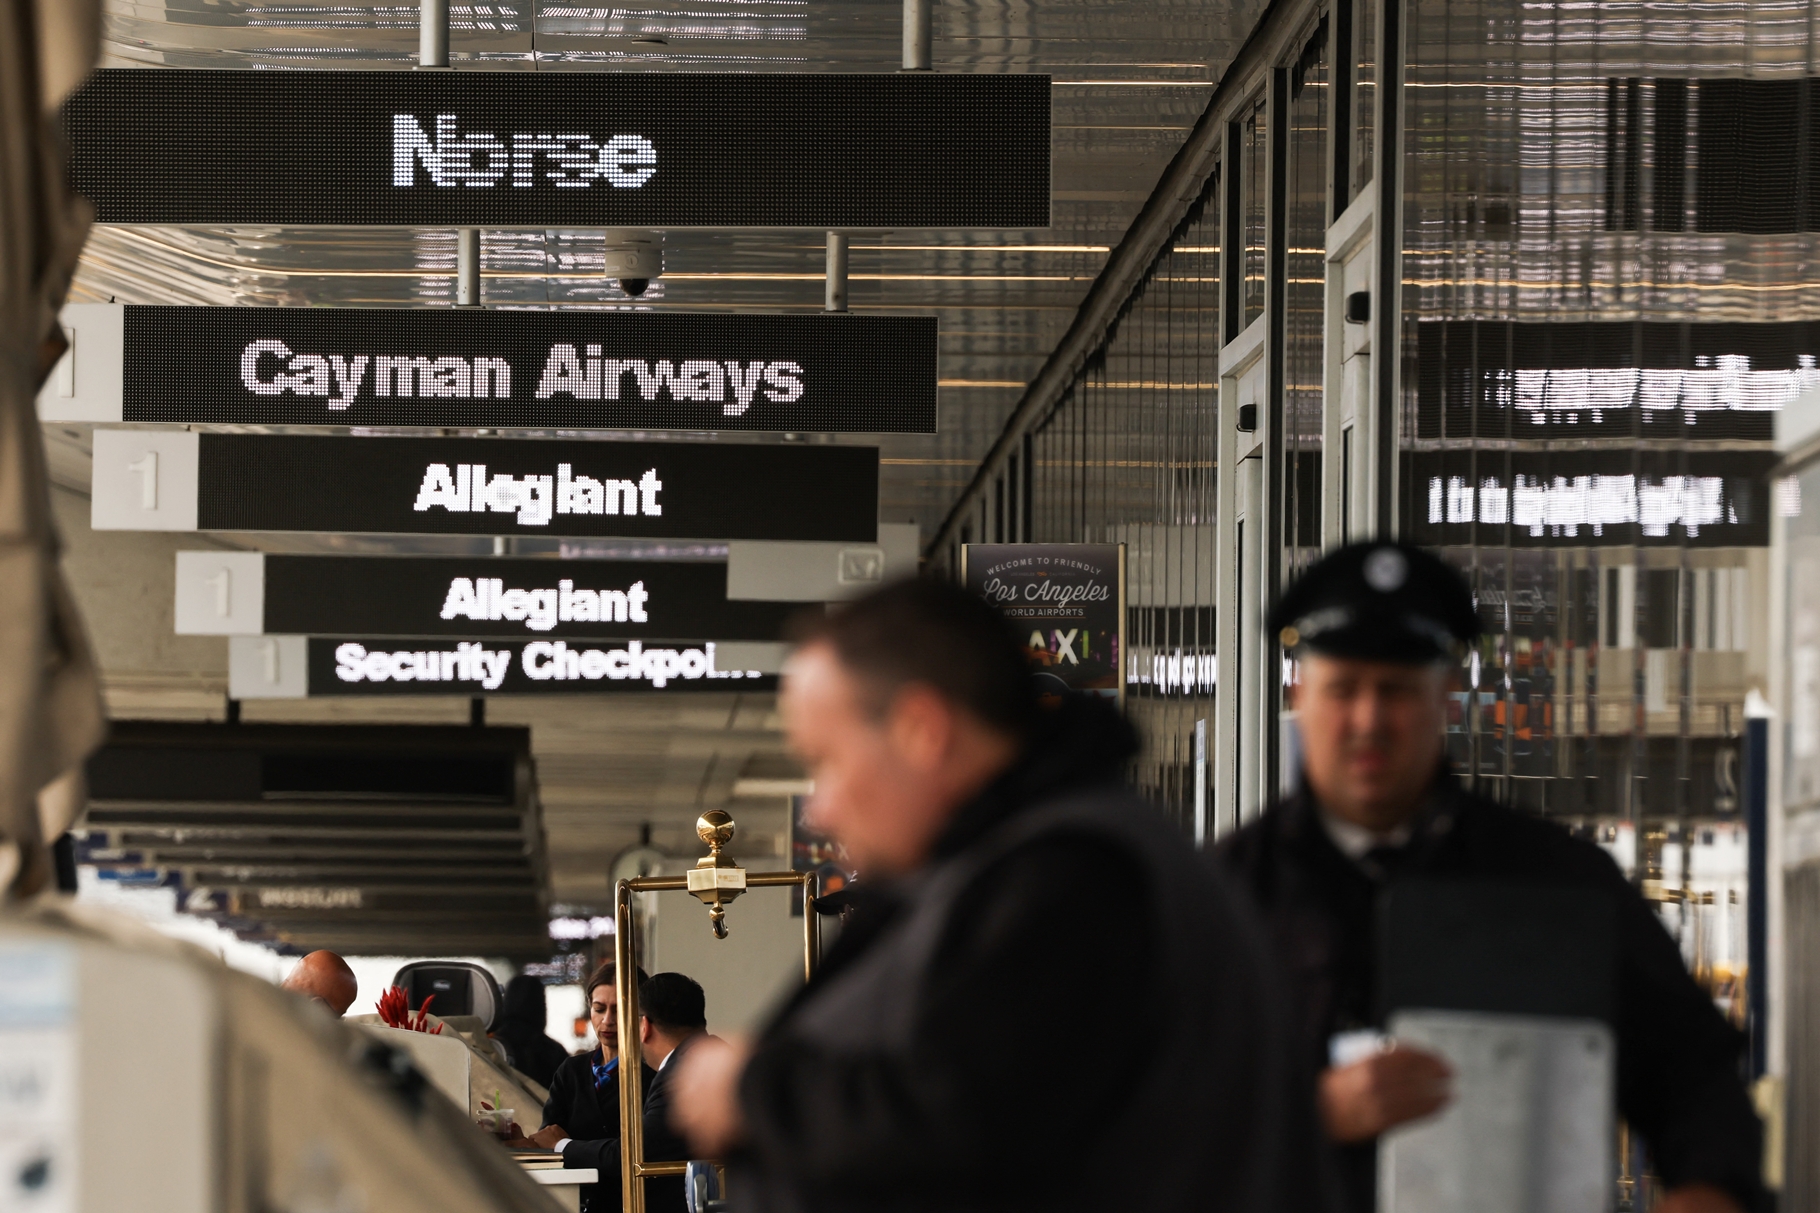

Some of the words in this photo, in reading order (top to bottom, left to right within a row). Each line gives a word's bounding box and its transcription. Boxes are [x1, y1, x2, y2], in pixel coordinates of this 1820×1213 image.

[393, 112, 657, 188] Norse
[240, 339, 511, 411] Cayman
[535, 343, 804, 416] Airways
[128, 450, 158, 511] 1
[414, 463, 662, 525] Allegiant
[986, 558, 1033, 576] WELCOME
[1037, 557, 1050, 565] TO
[1054, 557, 1102, 576] FRIENDLY
[440, 578, 648, 631] Allegiant
[982, 578, 1019, 608] Los
[1024, 579, 1110, 609] Angeles
[1004, 608, 1035, 617] WORLD
[1037, 608, 1084, 617] AIRPORTS
[336, 642, 512, 689] Security
